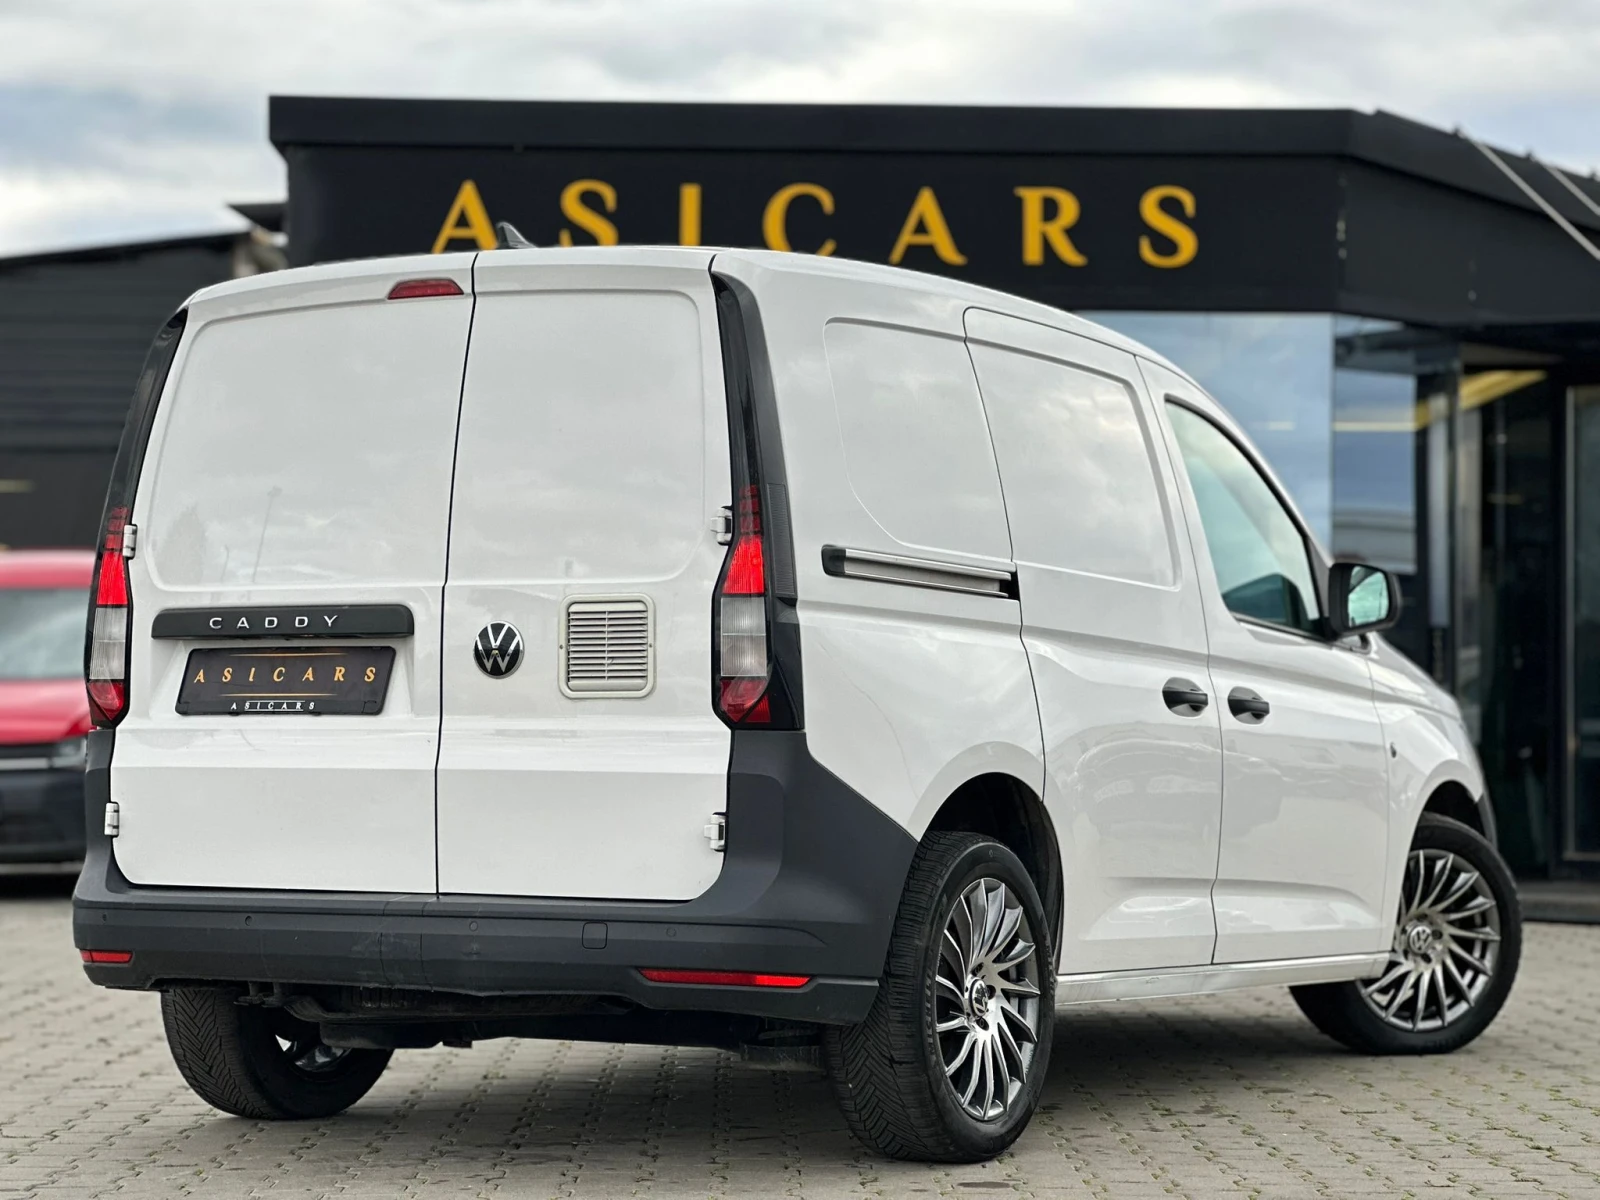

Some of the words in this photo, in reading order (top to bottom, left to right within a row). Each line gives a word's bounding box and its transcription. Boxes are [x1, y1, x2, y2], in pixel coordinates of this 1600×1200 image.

[432, 179, 1199, 269] ASICARS
[209, 615, 338, 629] CADDY
[194, 666, 376, 684] ASICARS
[230, 701, 315, 711] ASICARS
